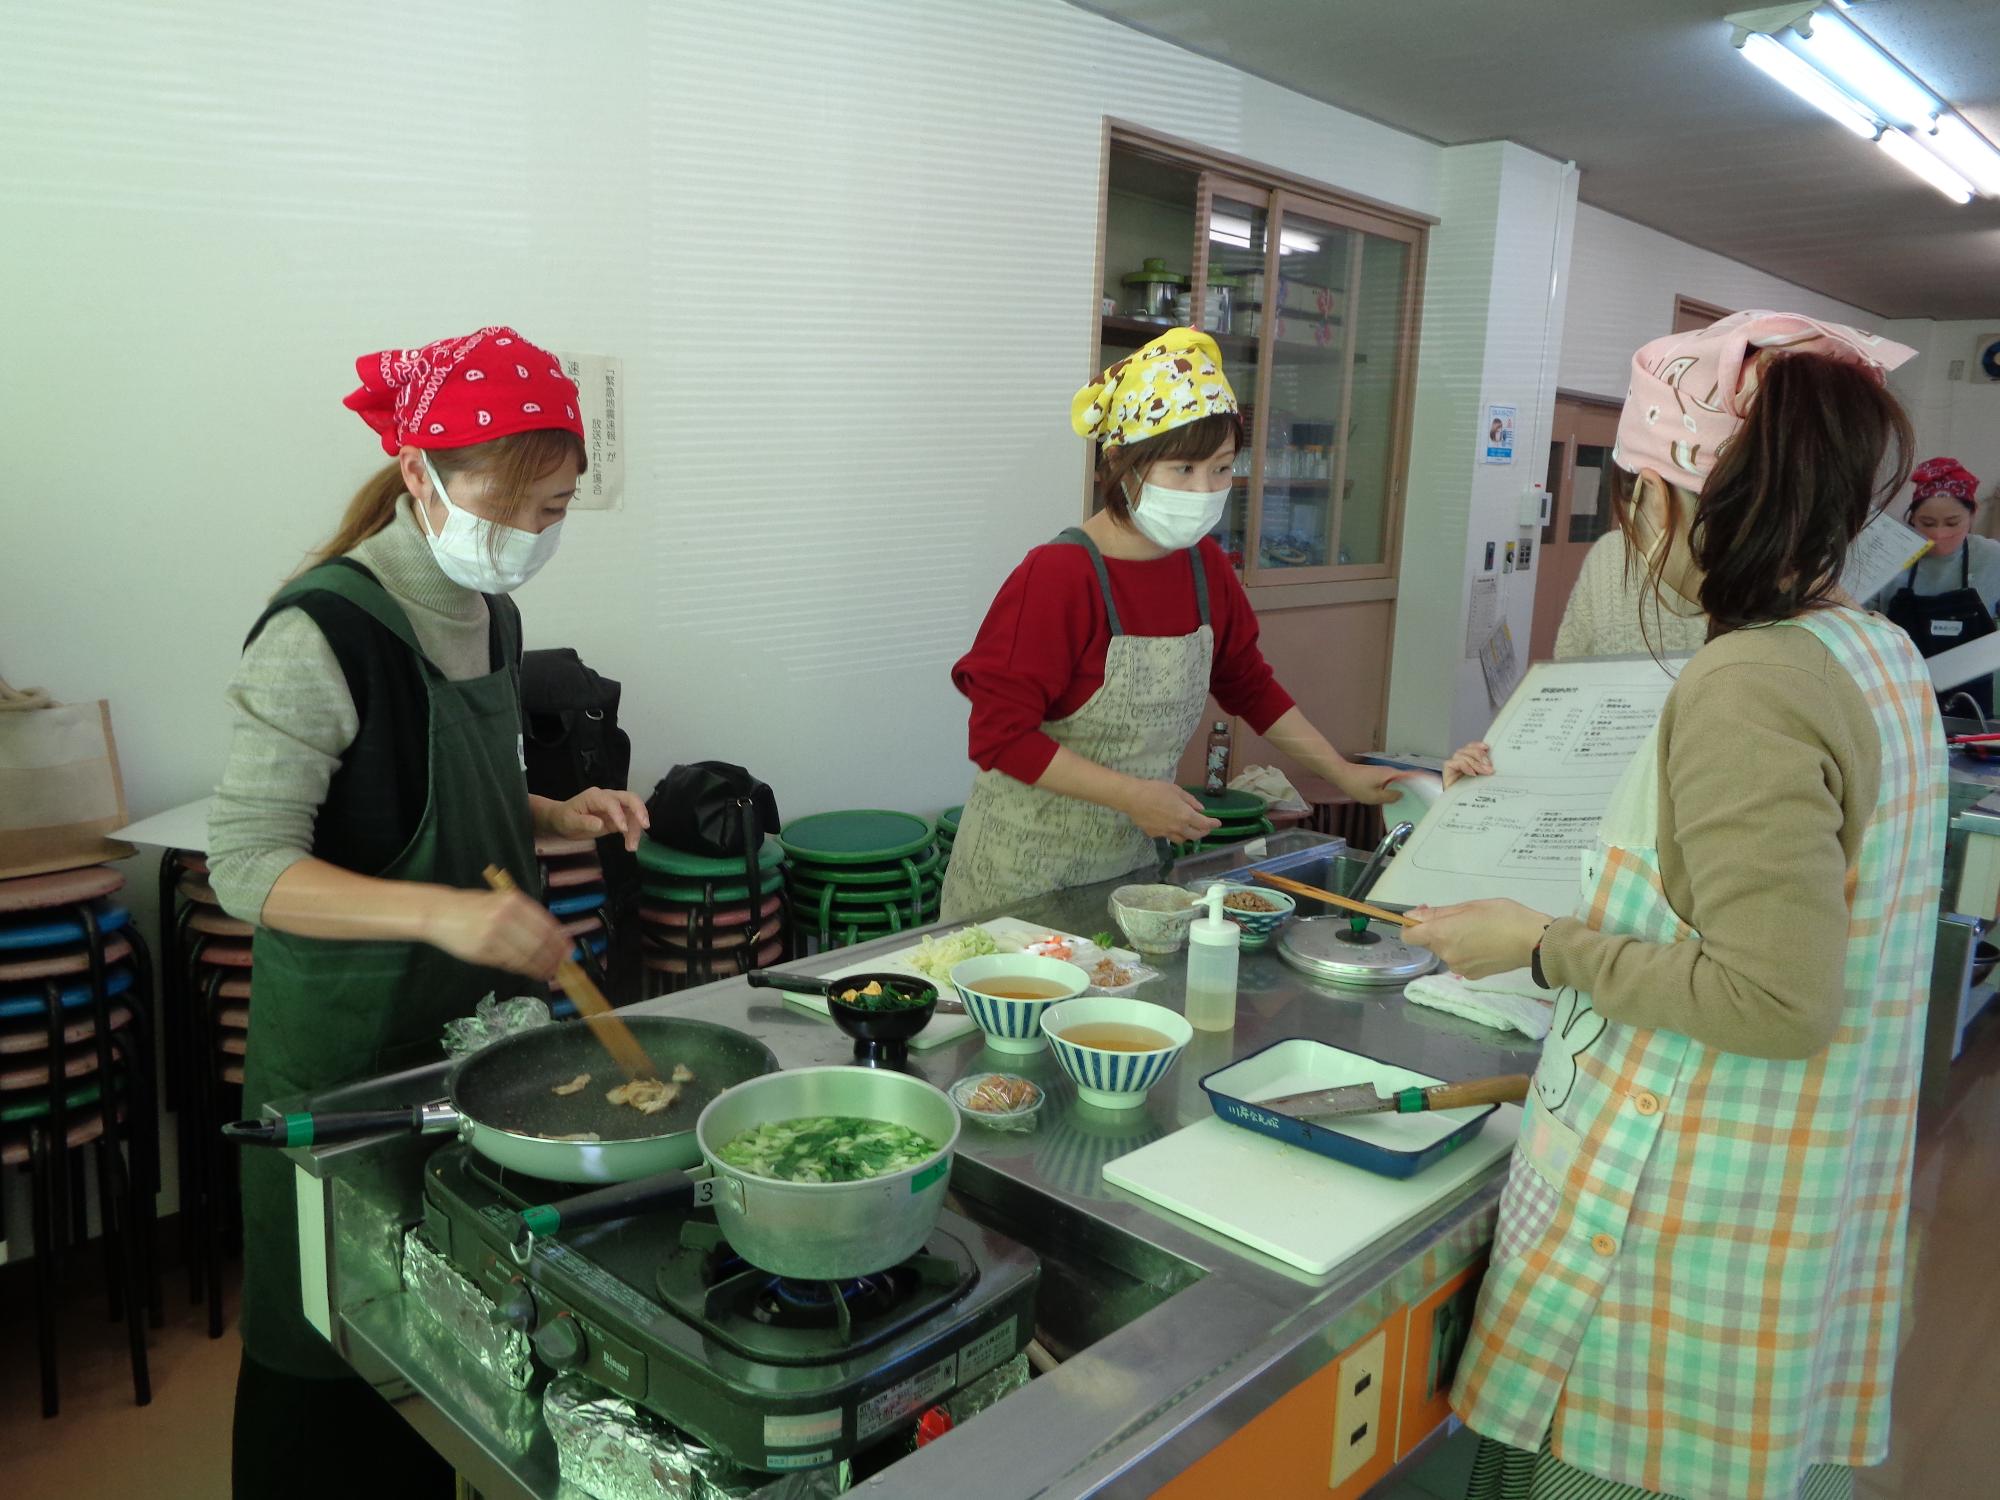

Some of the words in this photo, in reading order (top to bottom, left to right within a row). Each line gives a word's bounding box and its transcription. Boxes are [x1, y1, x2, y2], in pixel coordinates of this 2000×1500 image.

[592, 418, 603, 496] 放送された場合
[700, 1182, 713, 1202] 3
[603, 1351, 630, 1377] Rinnai
